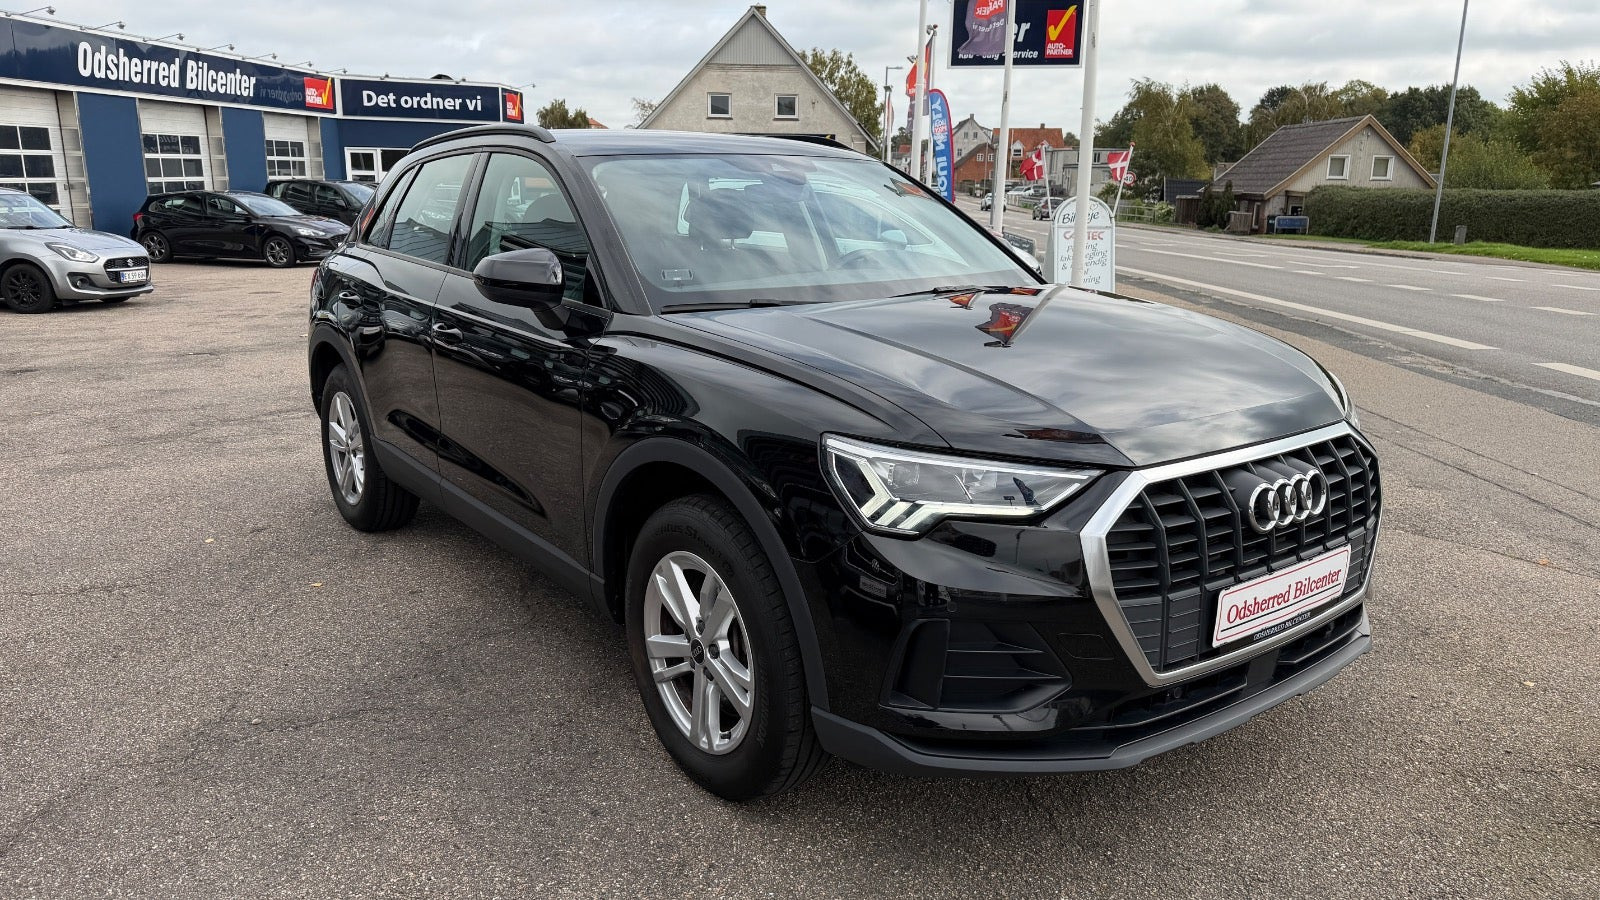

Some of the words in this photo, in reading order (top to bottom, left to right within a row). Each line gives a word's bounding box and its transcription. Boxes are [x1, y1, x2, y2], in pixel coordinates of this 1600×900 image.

[1012, 49, 1039, 59] ervice
[1046, 48, 1073, 56] PARTNER
[77, 41, 180, 87] Odsherred
[185, 59, 256, 97] Bilcenter
[362, 90, 396, 107] Det
[403, 92, 462, 111] ordner
[465, 95, 482, 112] vi
[1227, 584, 1292, 624] Odsherred
[1294, 568, 1342, 600] Bilcenter
